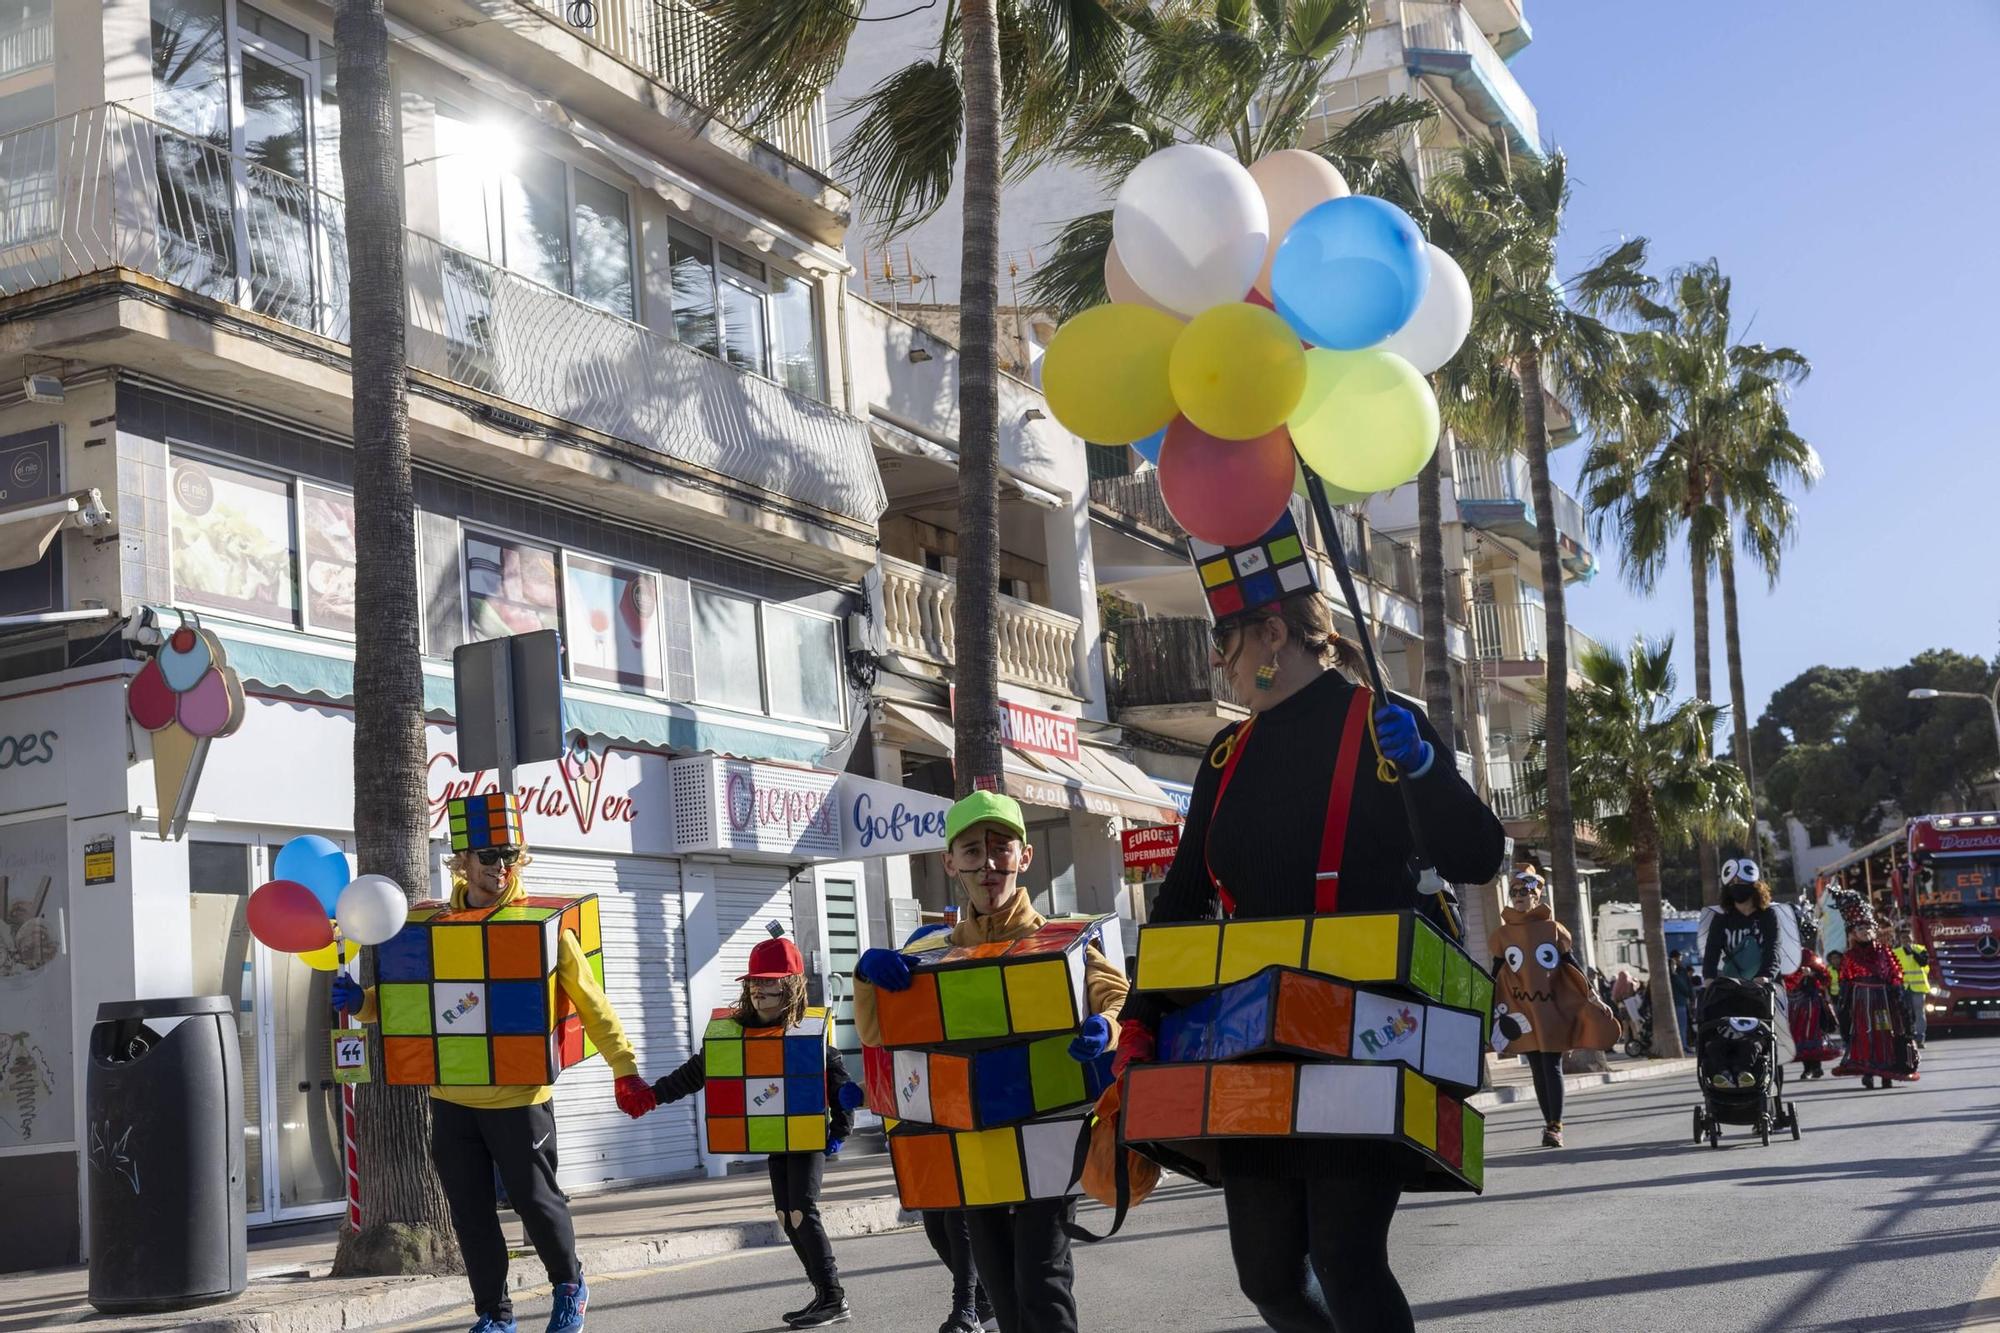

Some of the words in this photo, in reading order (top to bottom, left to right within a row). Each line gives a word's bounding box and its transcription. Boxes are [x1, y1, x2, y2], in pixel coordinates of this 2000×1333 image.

[1000, 705, 1075, 755] RMARKET
[726, 772, 834, 838] Crepes
[853, 792, 946, 848] Gofres
[341, 1043, 361, 1062] 44
